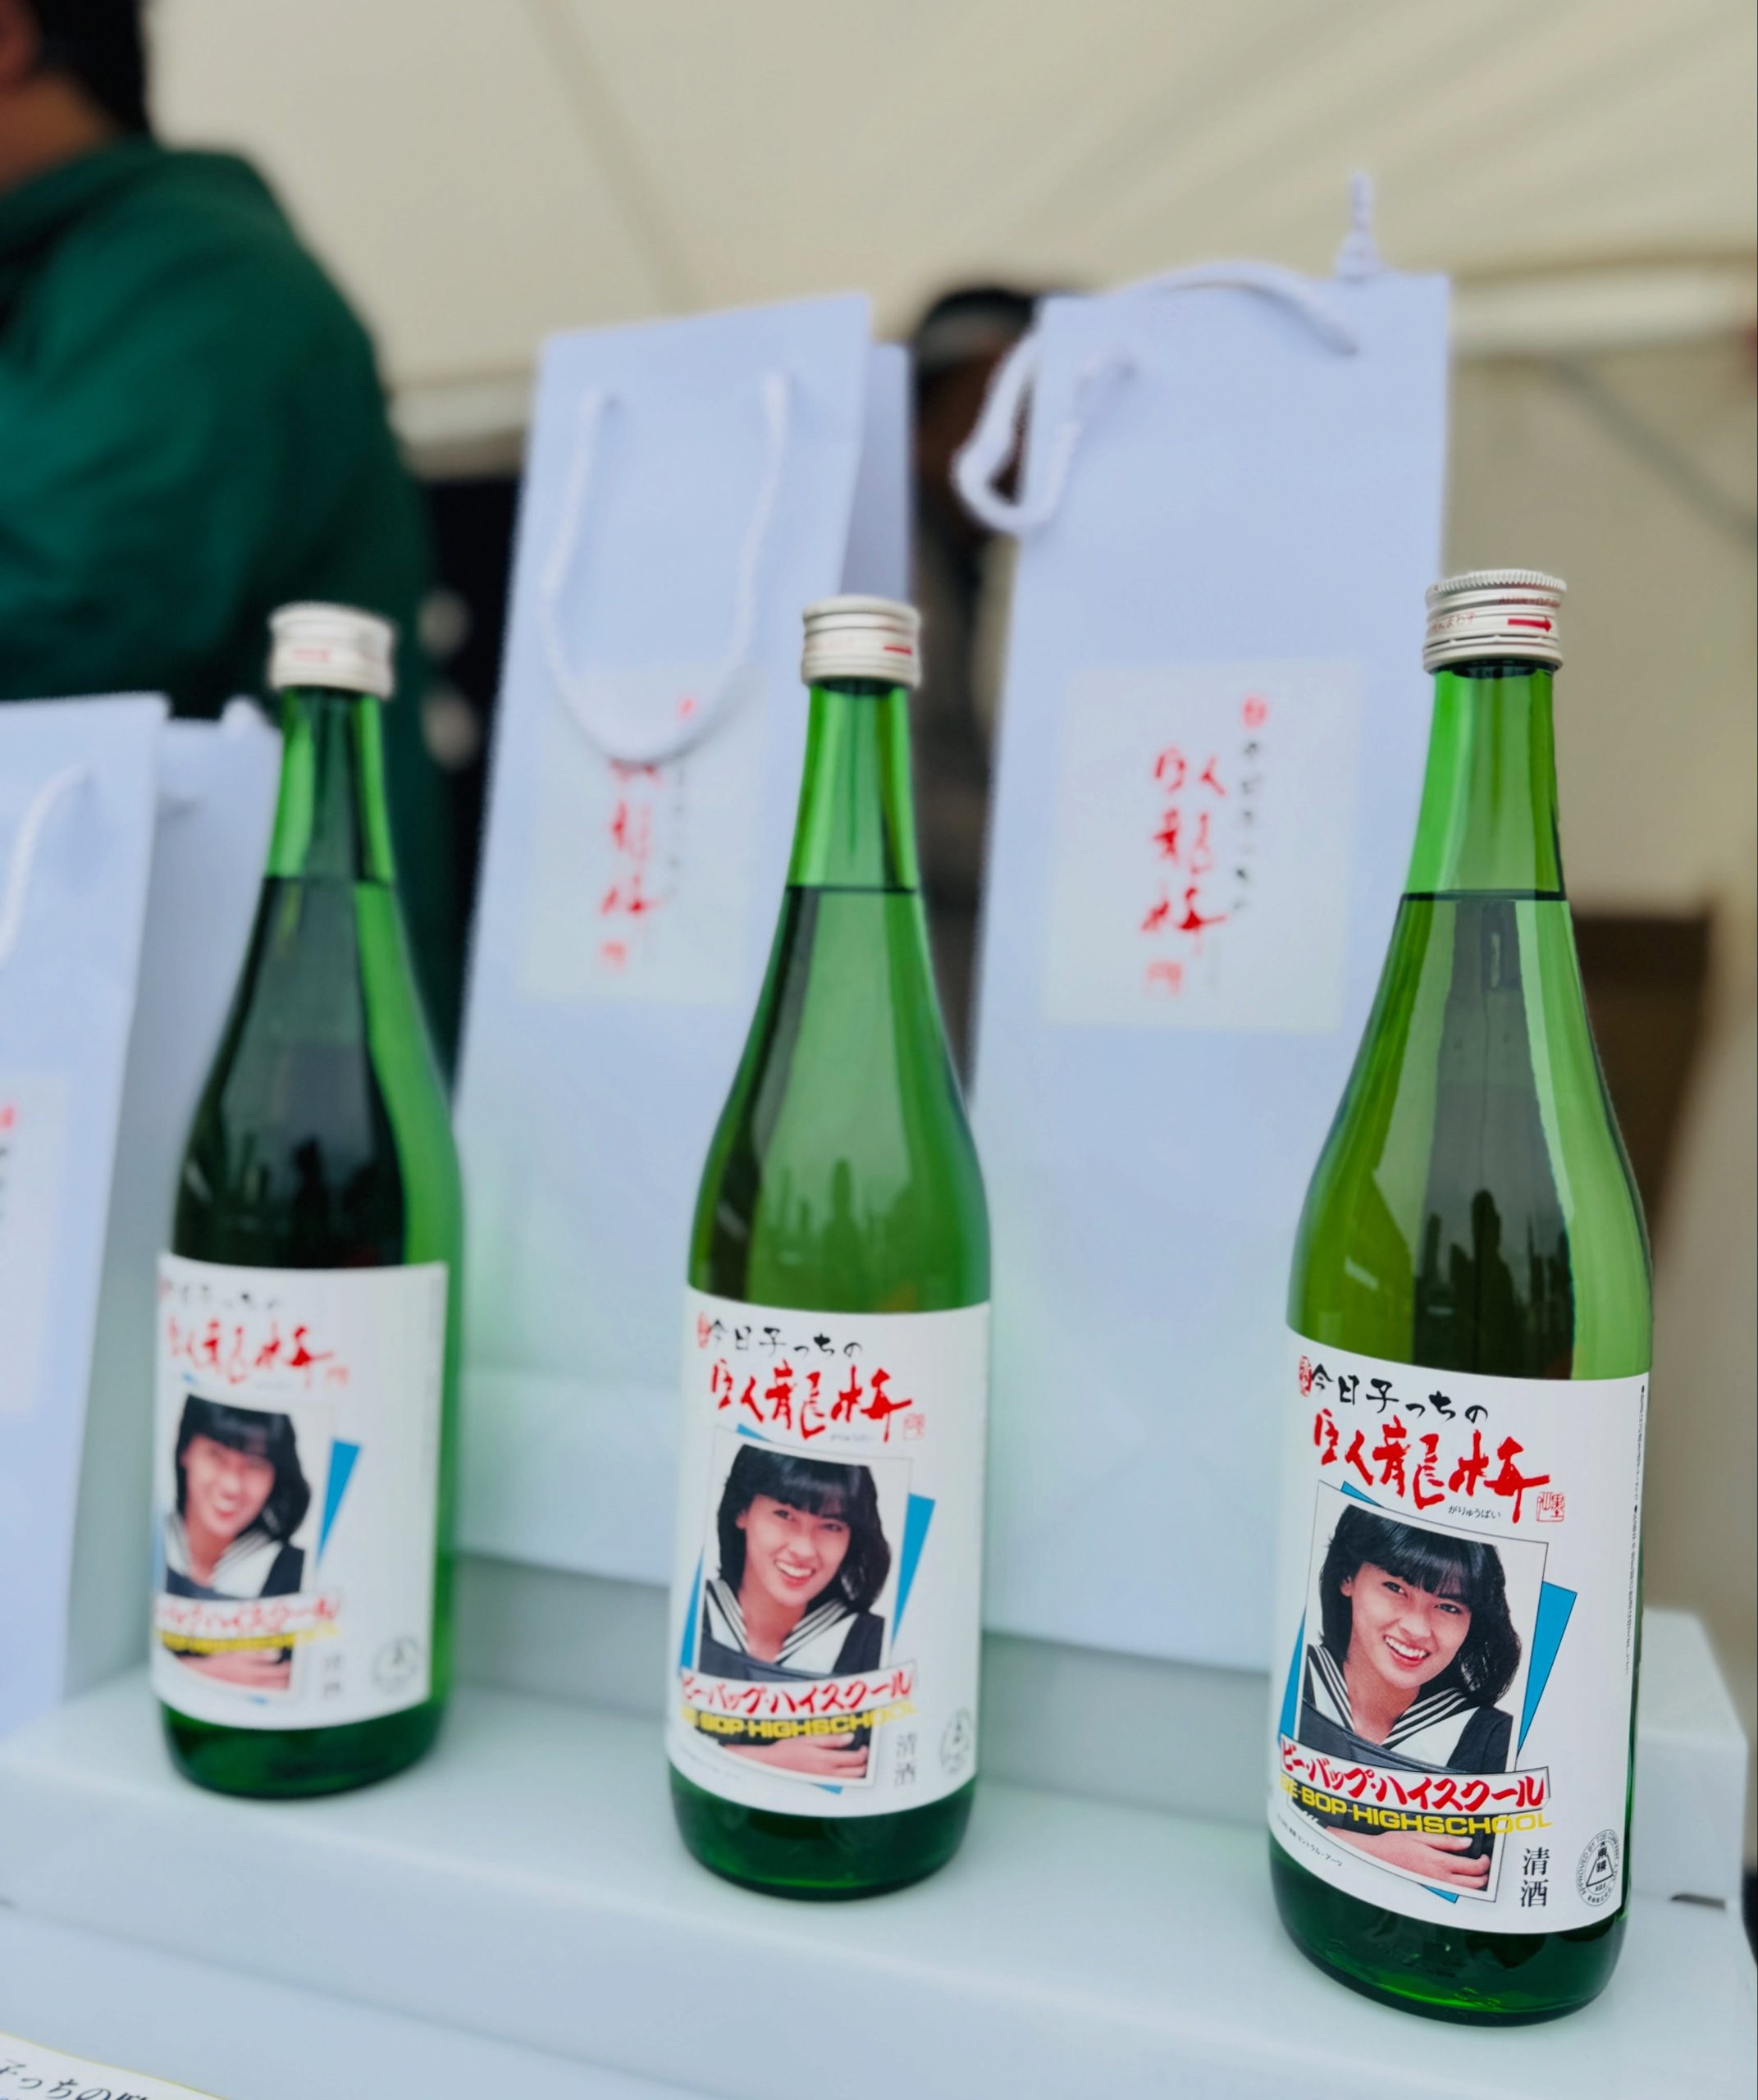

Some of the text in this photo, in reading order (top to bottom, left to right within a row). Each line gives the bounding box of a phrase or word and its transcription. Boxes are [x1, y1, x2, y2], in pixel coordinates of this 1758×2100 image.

[709, 1319, 863, 1357] 今日子っちの
[1311, 1363, 1489, 1425] 今日子っちの
[1313, 1408, 1550, 1524] 臥龍梅
[1448, 1504, 1501, 1519] がりゅうばい
[1281, 1736, 1546, 1812] ビー・バップ・ハイスクール
[1521, 1847, 1550, 1908] 清酒
